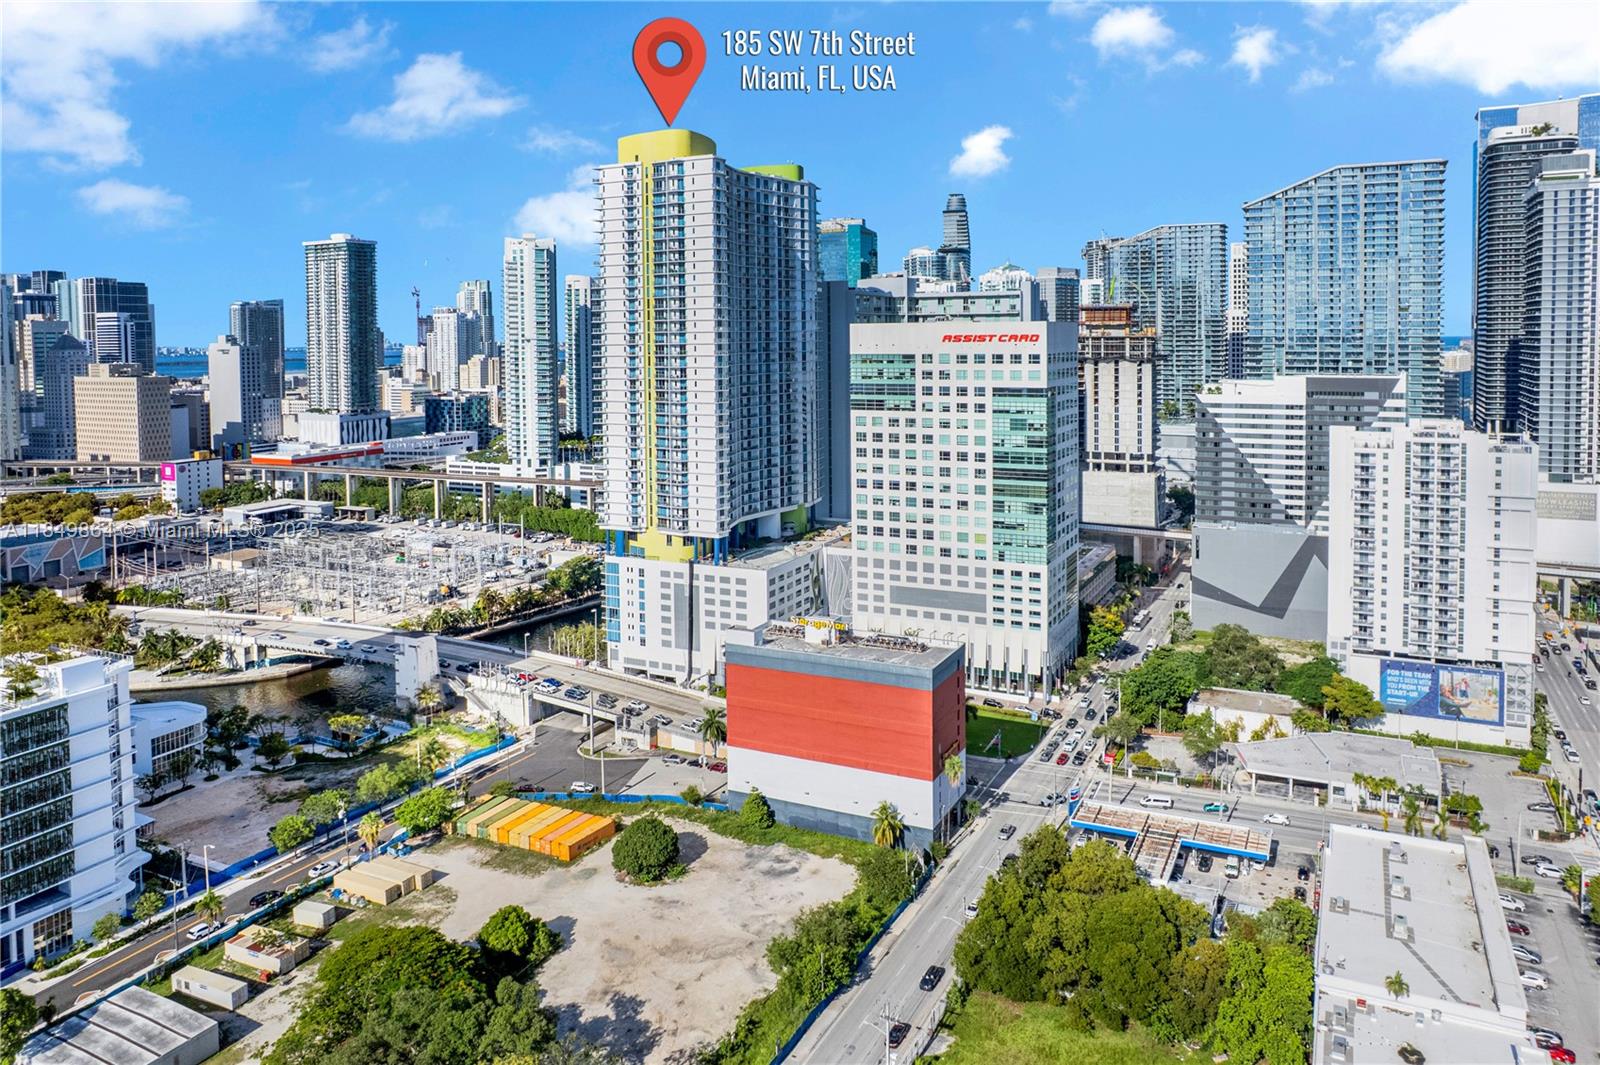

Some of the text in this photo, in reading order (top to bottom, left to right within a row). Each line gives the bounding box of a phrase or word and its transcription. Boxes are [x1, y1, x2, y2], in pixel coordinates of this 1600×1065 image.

[942, 334, 1040, 343] ASSIST CARD
[1414, 671, 1432, 679] TEAM
